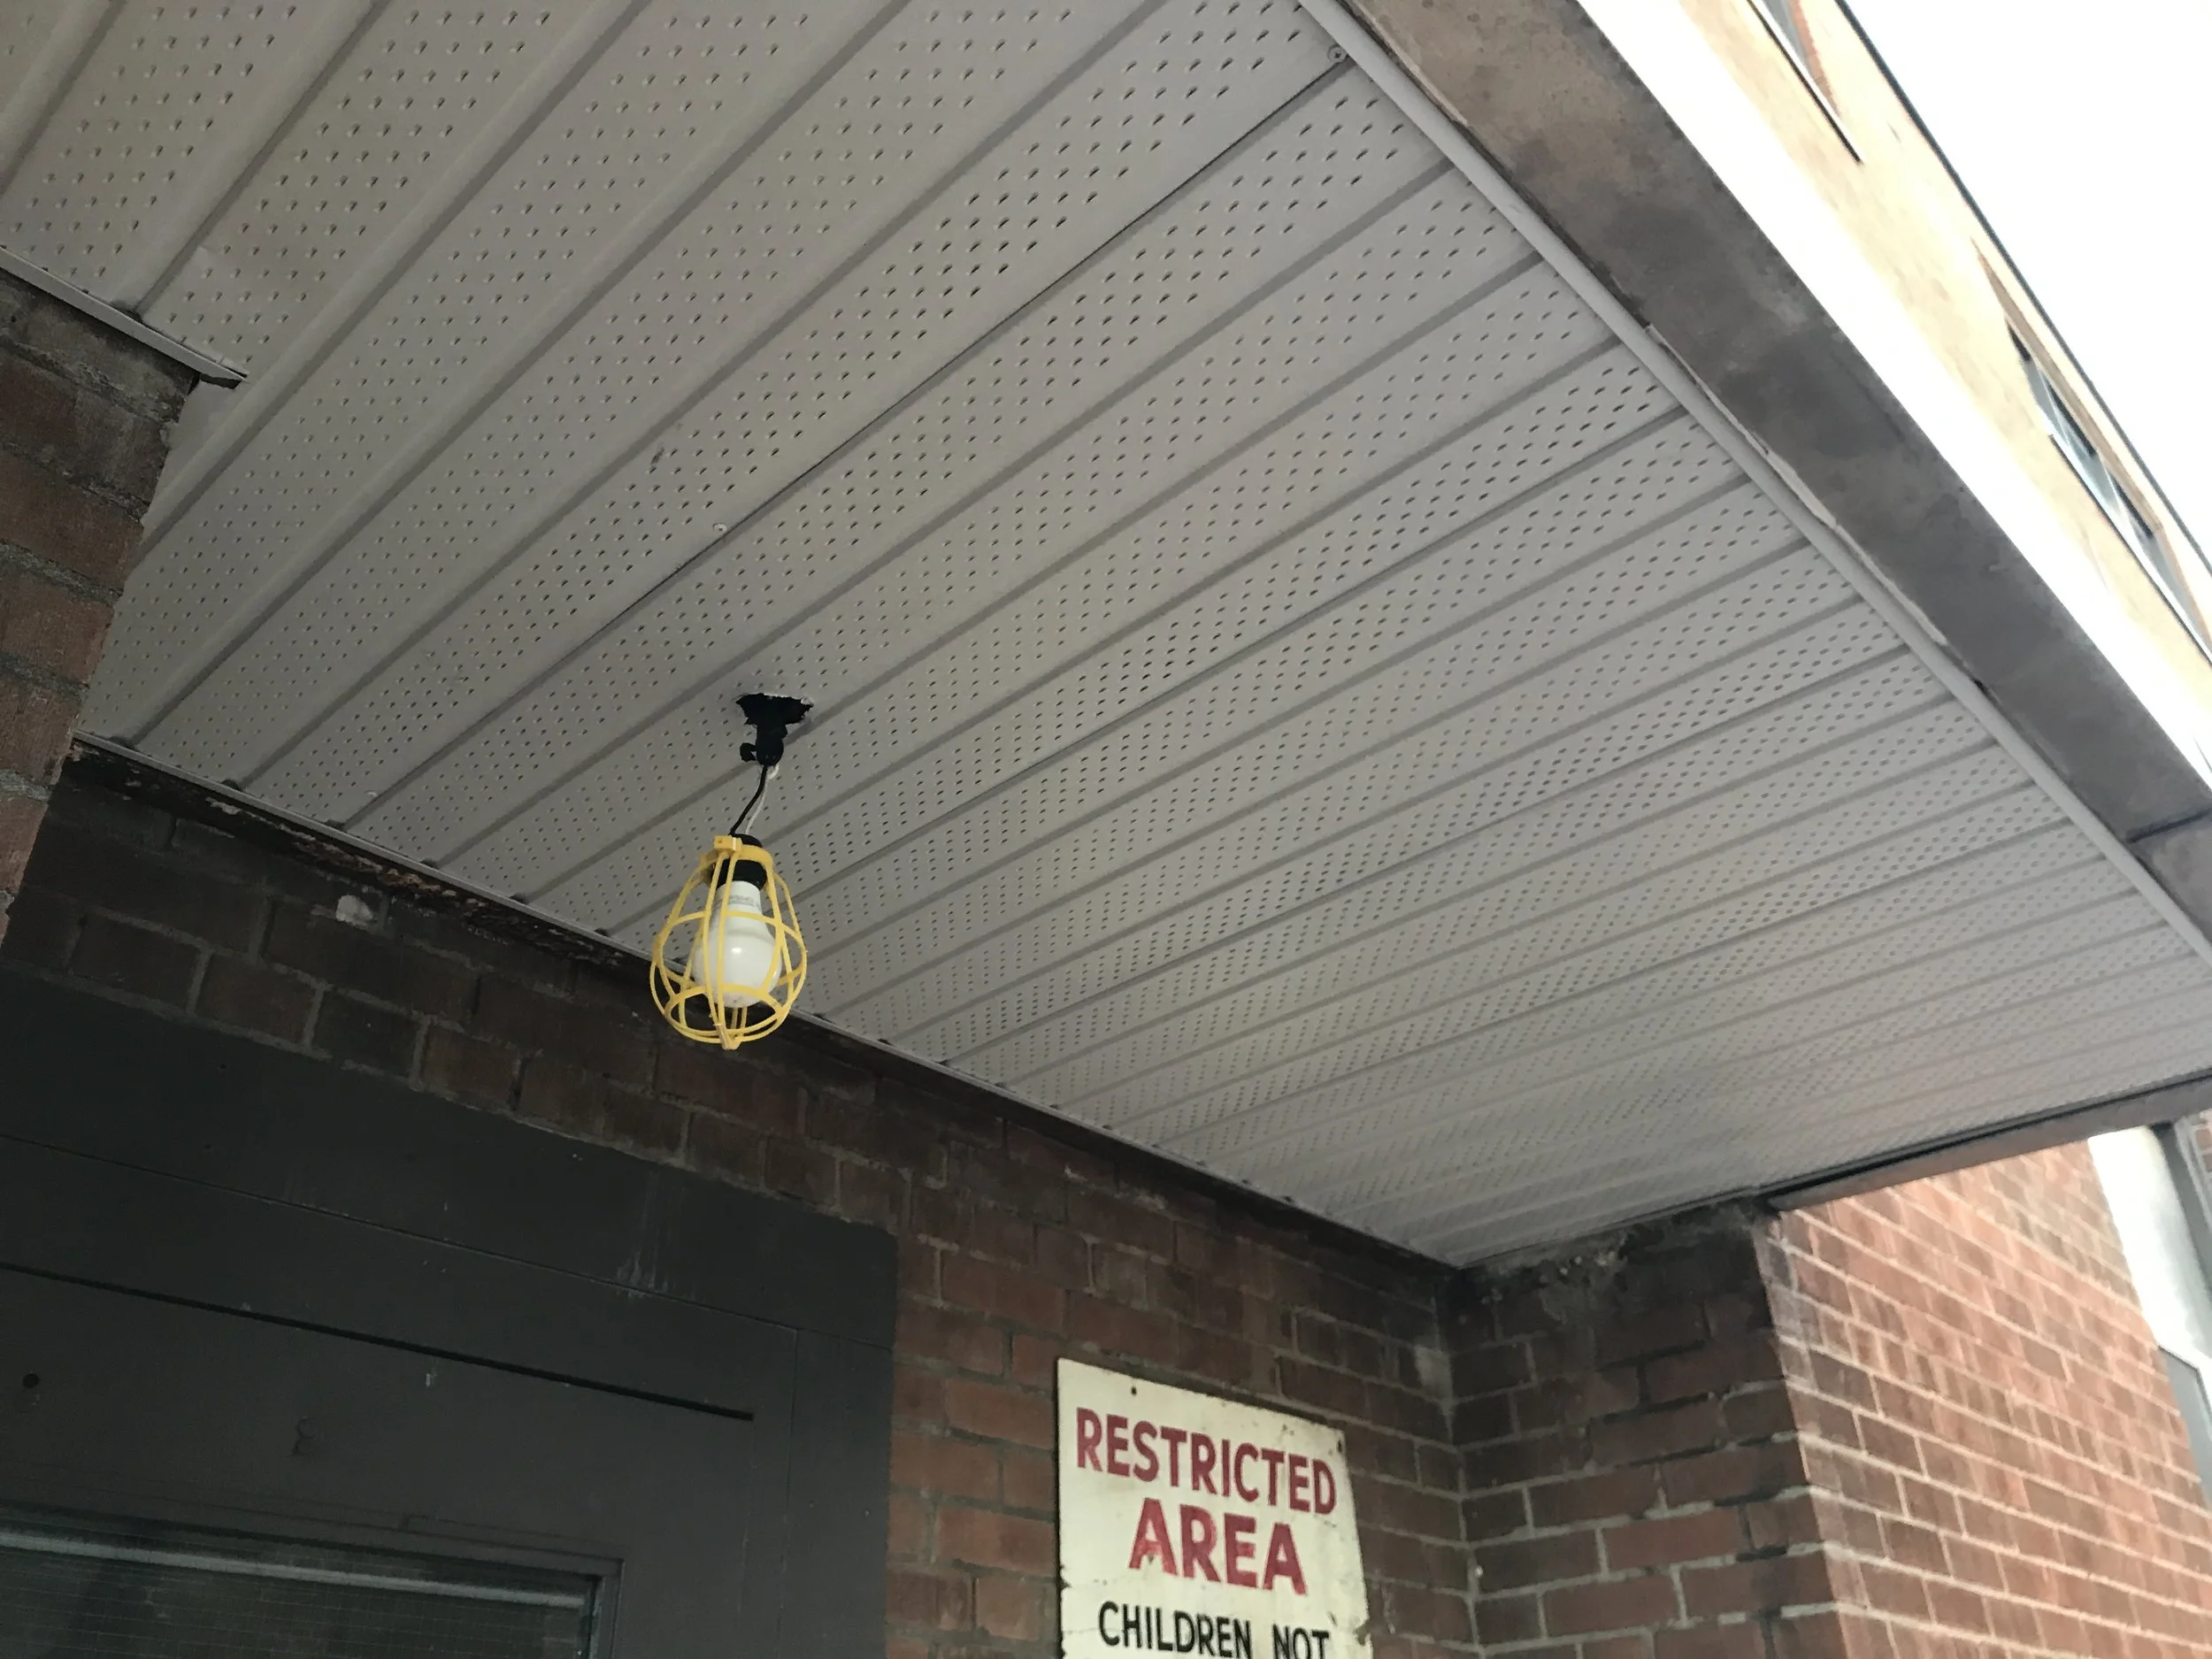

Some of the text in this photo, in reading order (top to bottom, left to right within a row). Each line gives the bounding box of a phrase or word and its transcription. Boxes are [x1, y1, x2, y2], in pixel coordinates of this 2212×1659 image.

[1076, 1407, 1337, 1515] RESTRICTED
[1128, 1497, 1308, 1596] AREA
[1098, 1601, 1330, 1659] CHILDREN NOT
